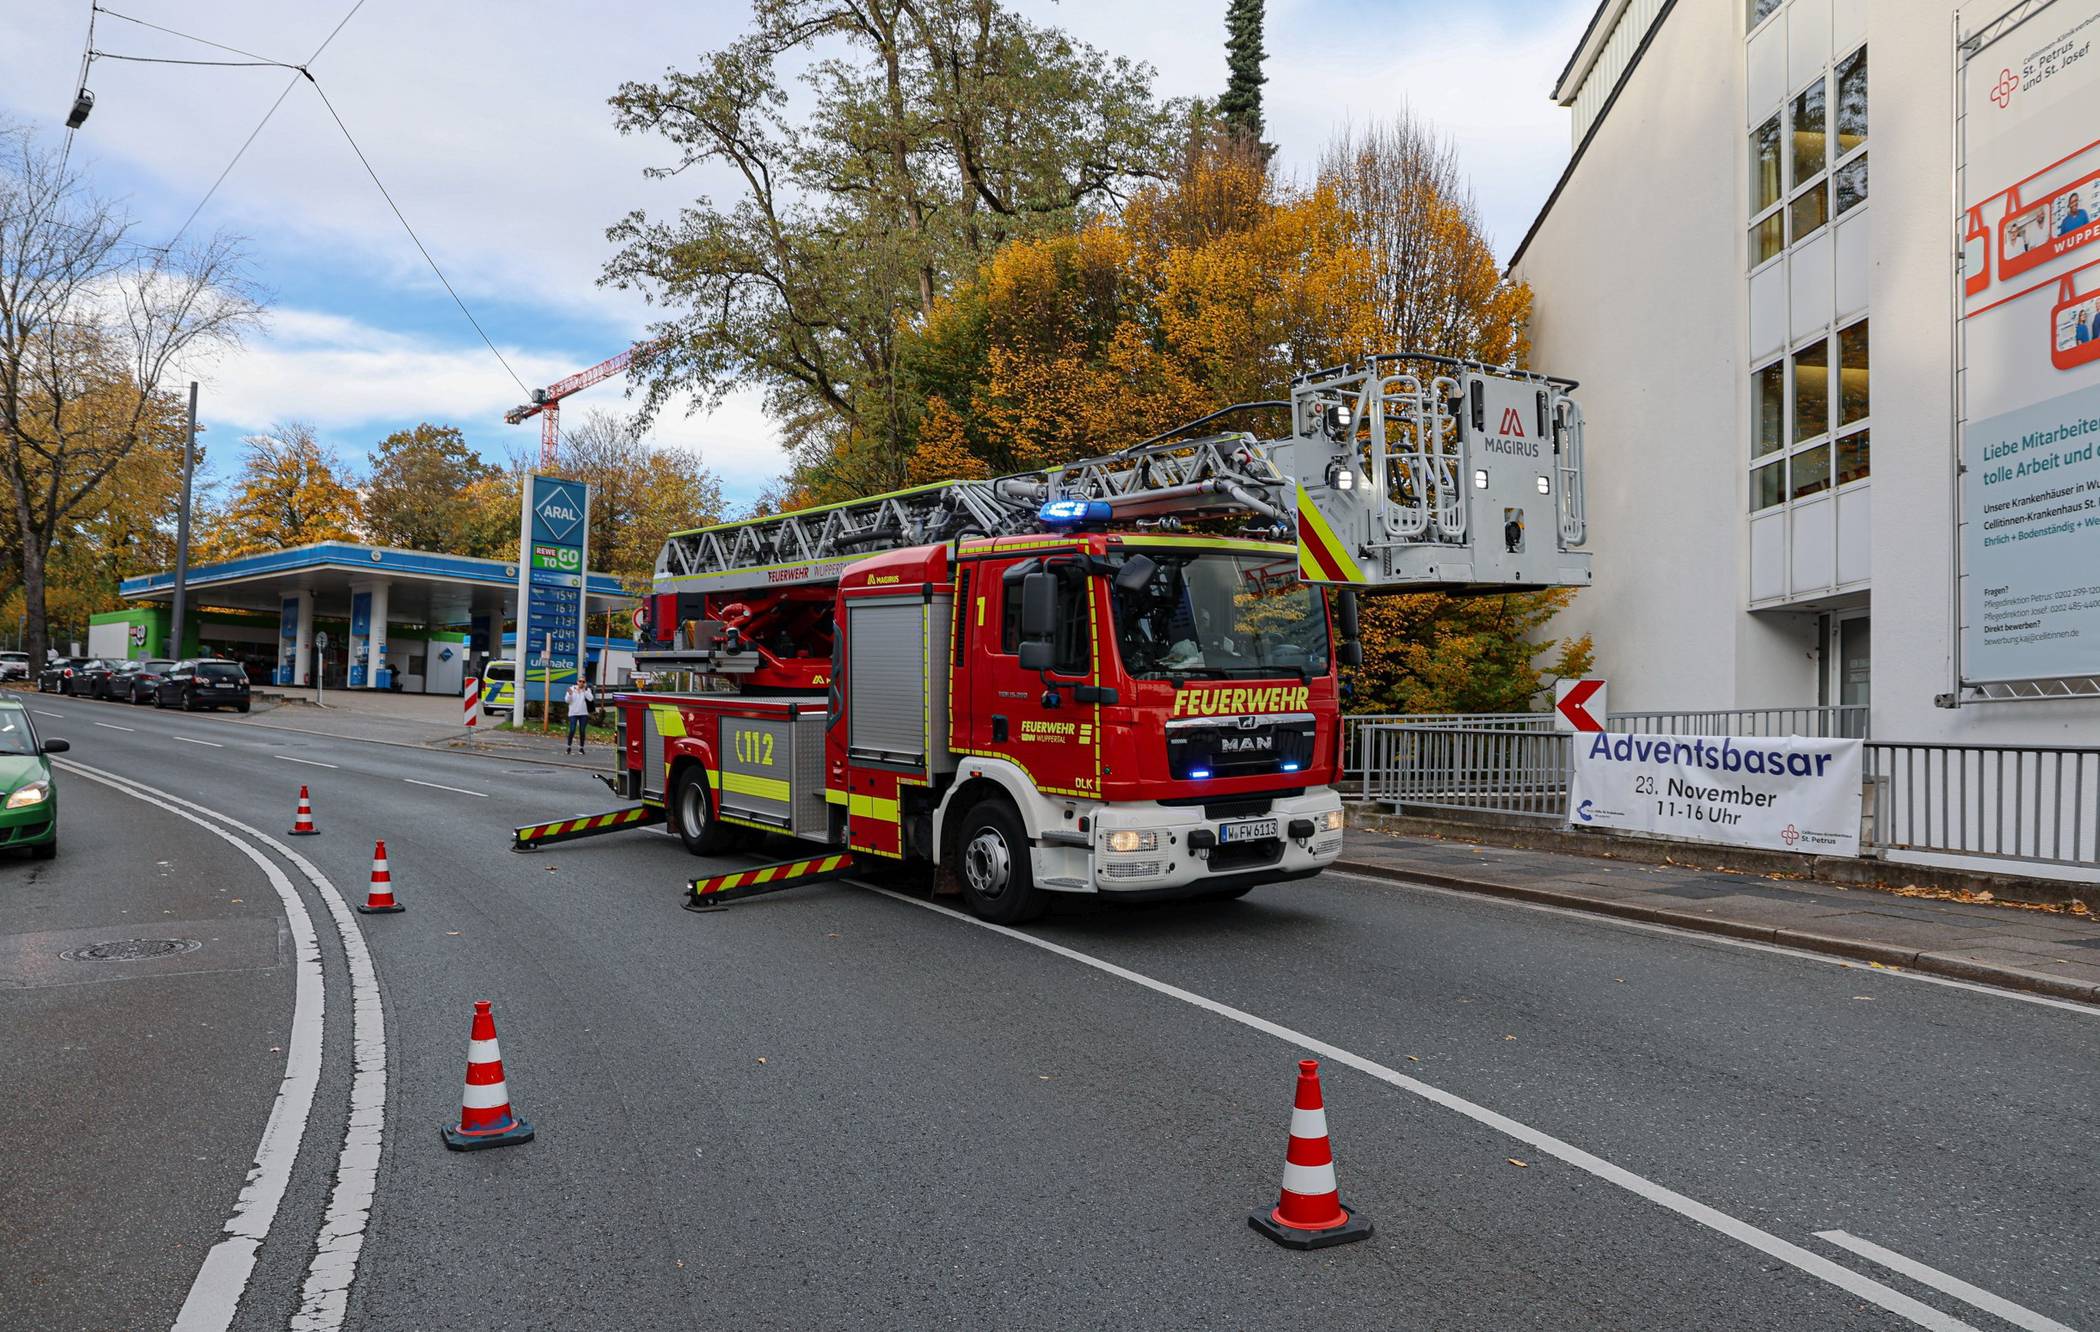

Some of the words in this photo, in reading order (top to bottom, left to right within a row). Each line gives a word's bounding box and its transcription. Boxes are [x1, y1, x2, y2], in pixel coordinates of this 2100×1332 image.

[2023, 65, 2036, 78] St.
[2039, 40, 2074, 67] Petrus
[2023, 71, 2042, 91] und
[2044, 65, 2058, 78] St.
[2061, 41, 2090, 68] Josef
[1484, 437, 1539, 458] MAGIRUS
[1983, 441, 2018, 462] Liebe
[2022, 418, 2100, 451] Mitarbeite
[1983, 466, 2013, 486] tolle
[2016, 453, 2060, 478] Arbeit
[2064, 442, 2093, 466] und
[1983, 501, 2011, 514] Unsere
[2011, 487, 2075, 507] Krankenhäuser
[2075, 483, 2085, 494] in
[543, 505, 576, 520] ARAL
[1983, 502, 2083, 530] Cellitinnen-Krankenhaus
[2084, 499, 2097, 510] St.
[1983, 535, 2010, 547] Ehrlich
[2018, 520, 2075, 541] Bodenständig
[536, 546, 556, 556] REWE
[558, 548, 579, 563] GO
[542, 557, 557, 567] TO
[767, 566, 809, 583] FEUERWEHR
[1984, 585, 2009, 597] Fragen?
[976, 596, 985, 626] 1
[1984, 625, 2004, 633] Direkt
[2004, 619, 2041, 631] bewerben?
[1173, 686, 1309, 716] FEUERWEHR
[1021, 720, 1075, 735] FEUERWEHR
[744, 731, 774, 765] 112
[1036, 734, 1066, 744] WUPPERTAL
[1221, 736, 1272, 752] MAN
[1589, 732, 1832, 777] Adventsbasar
[1075, 777, 1093, 789] DLK
[1635, 775, 1658, 795] 23.
[1667, 778, 1777, 807] November
[1657, 800, 1704, 820] 11-16
[1708, 806, 1741, 825] Uhr
[1254, 822, 1276, 836] 6113
[1811, 836, 1836, 845] Petrus
